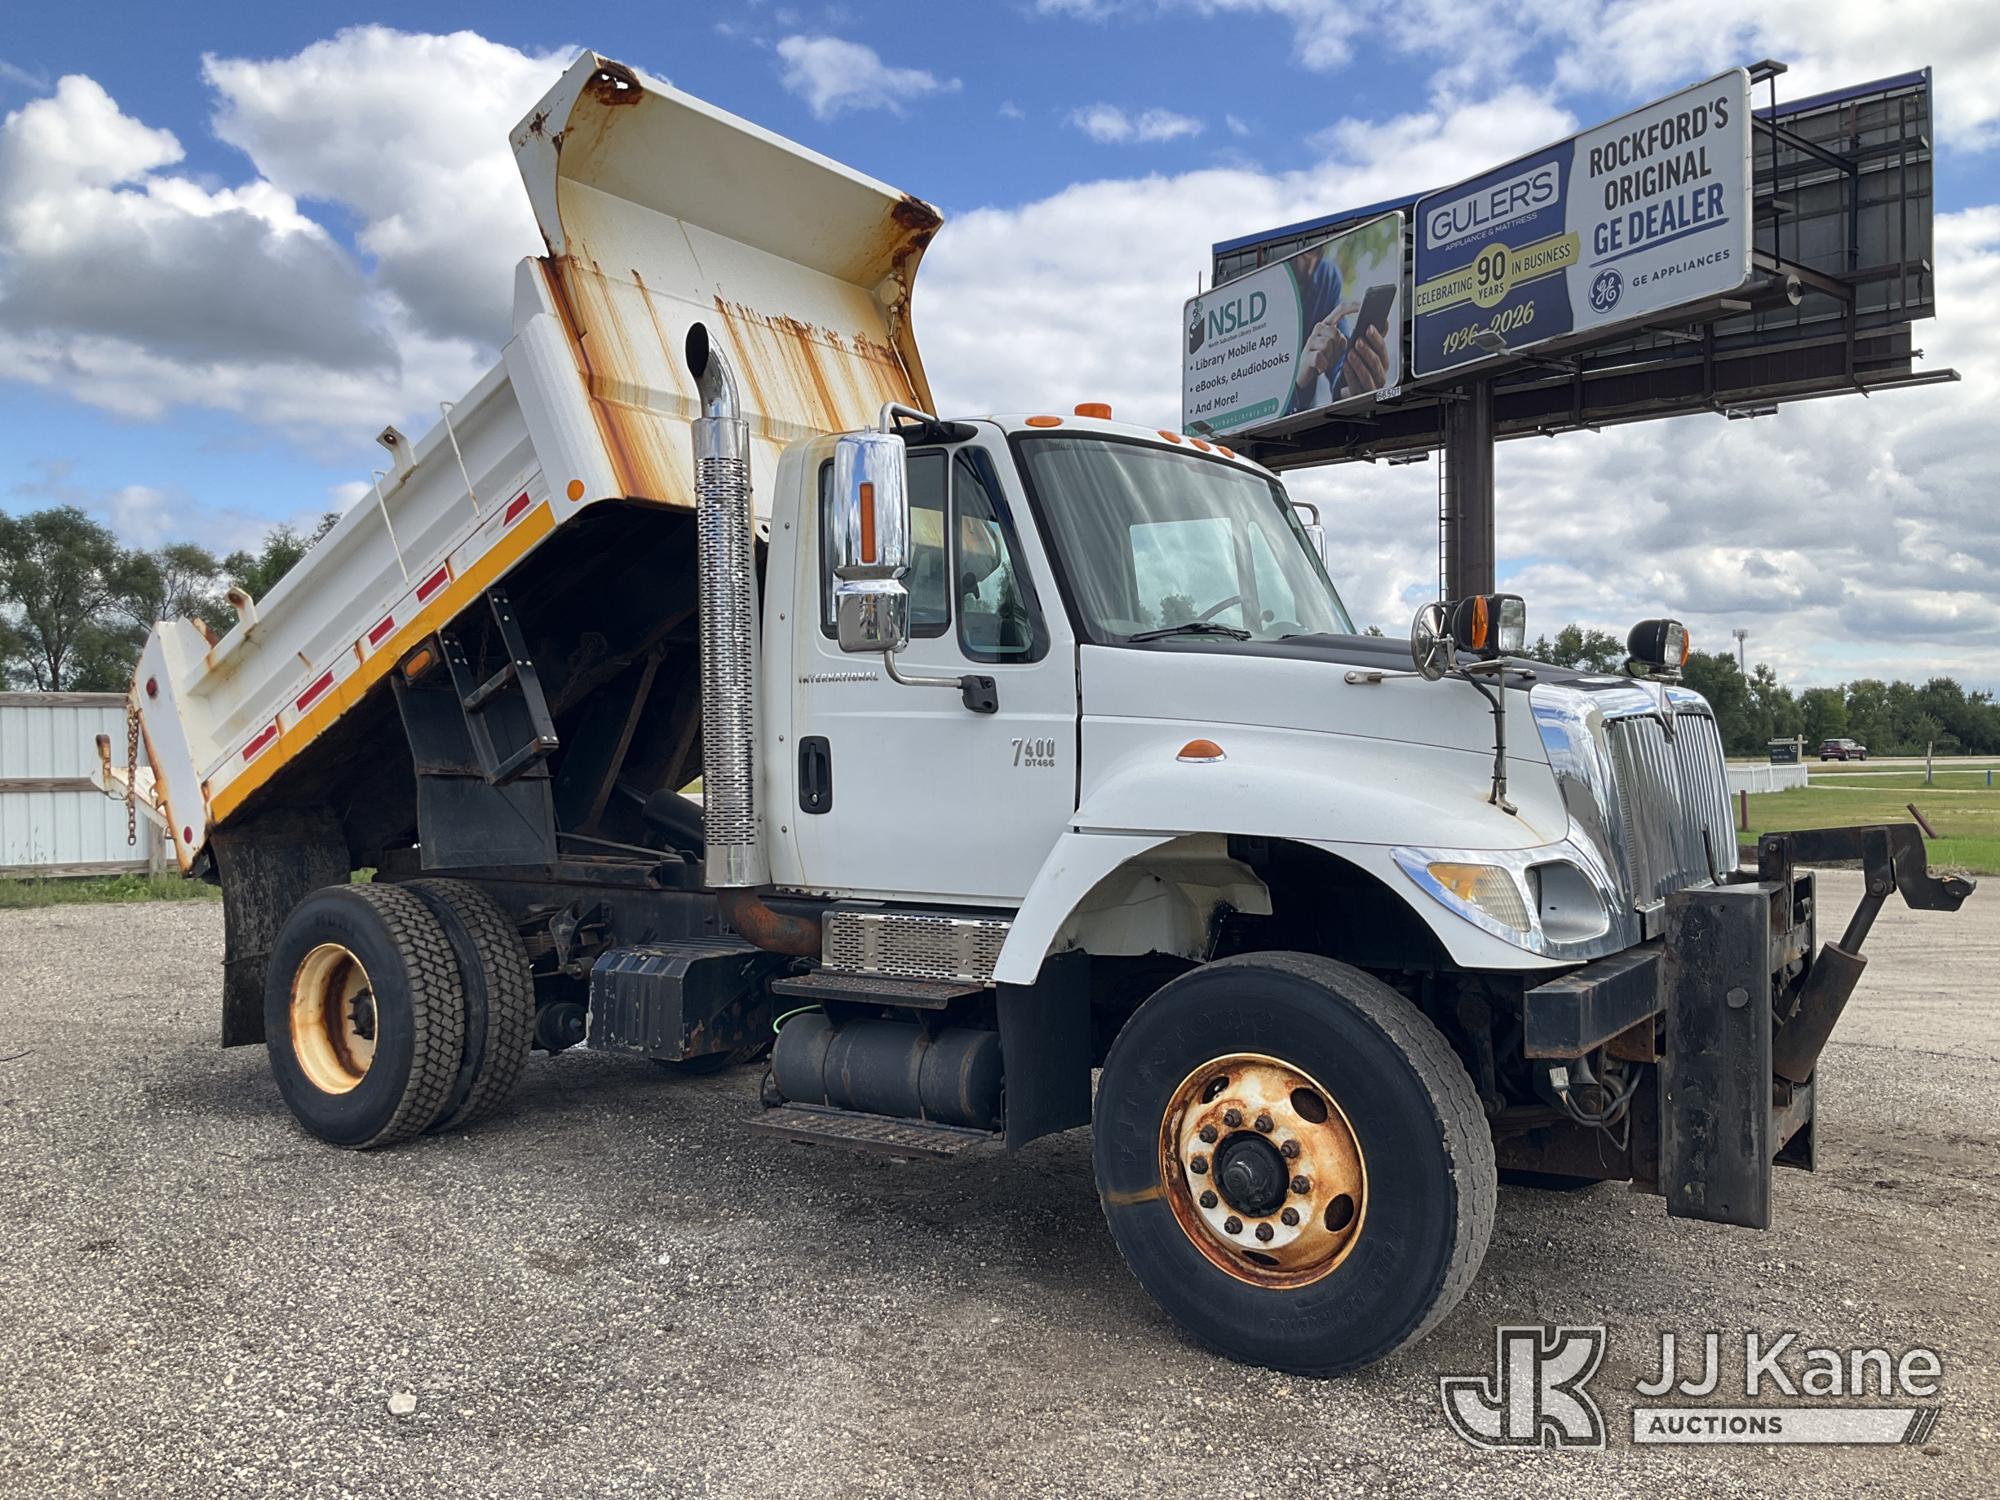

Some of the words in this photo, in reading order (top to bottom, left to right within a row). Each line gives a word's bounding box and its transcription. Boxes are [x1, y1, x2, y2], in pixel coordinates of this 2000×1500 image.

[1590, 96, 1729, 179] ROCKFORD'S
[1604, 146, 1712, 211] ORIGINAL
[1444, 230, 1486, 252] APPLIANCE
[1487, 227, 1494, 236] &
[1495, 212, 1538, 233] MATTRESS
[1594, 216, 1622, 256] GE
[1628, 182, 1724, 246] DEALER
[1477, 250, 1506, 286] 90
[1511, 258, 1521, 275] IN
[1524, 243, 1571, 271] BUSINESS
[1632, 274, 1648, 287] GE
[1652, 249, 1730, 282] APPLIANCES
[1416, 277, 1473, 307] CELEBRATING
[1478, 282, 1504, 300] YEARS
[1208, 291, 1266, 340] NSLD
[1195, 354, 1225, 371] Library
[1228, 340, 1256, 360] Mobile
[1259, 334, 1277, 348] App
[1195, 375, 1228, 393] eBooks,
[1231, 353, 1290, 380] eAudiobooks
[1195, 401, 1211, 415] And
[1214, 391, 1238, 409] More!
[798, 671, 879, 684] INTERNATIONAL
[1011, 737, 1055, 767] 7400
[1025, 759, 1055, 767] DT466
